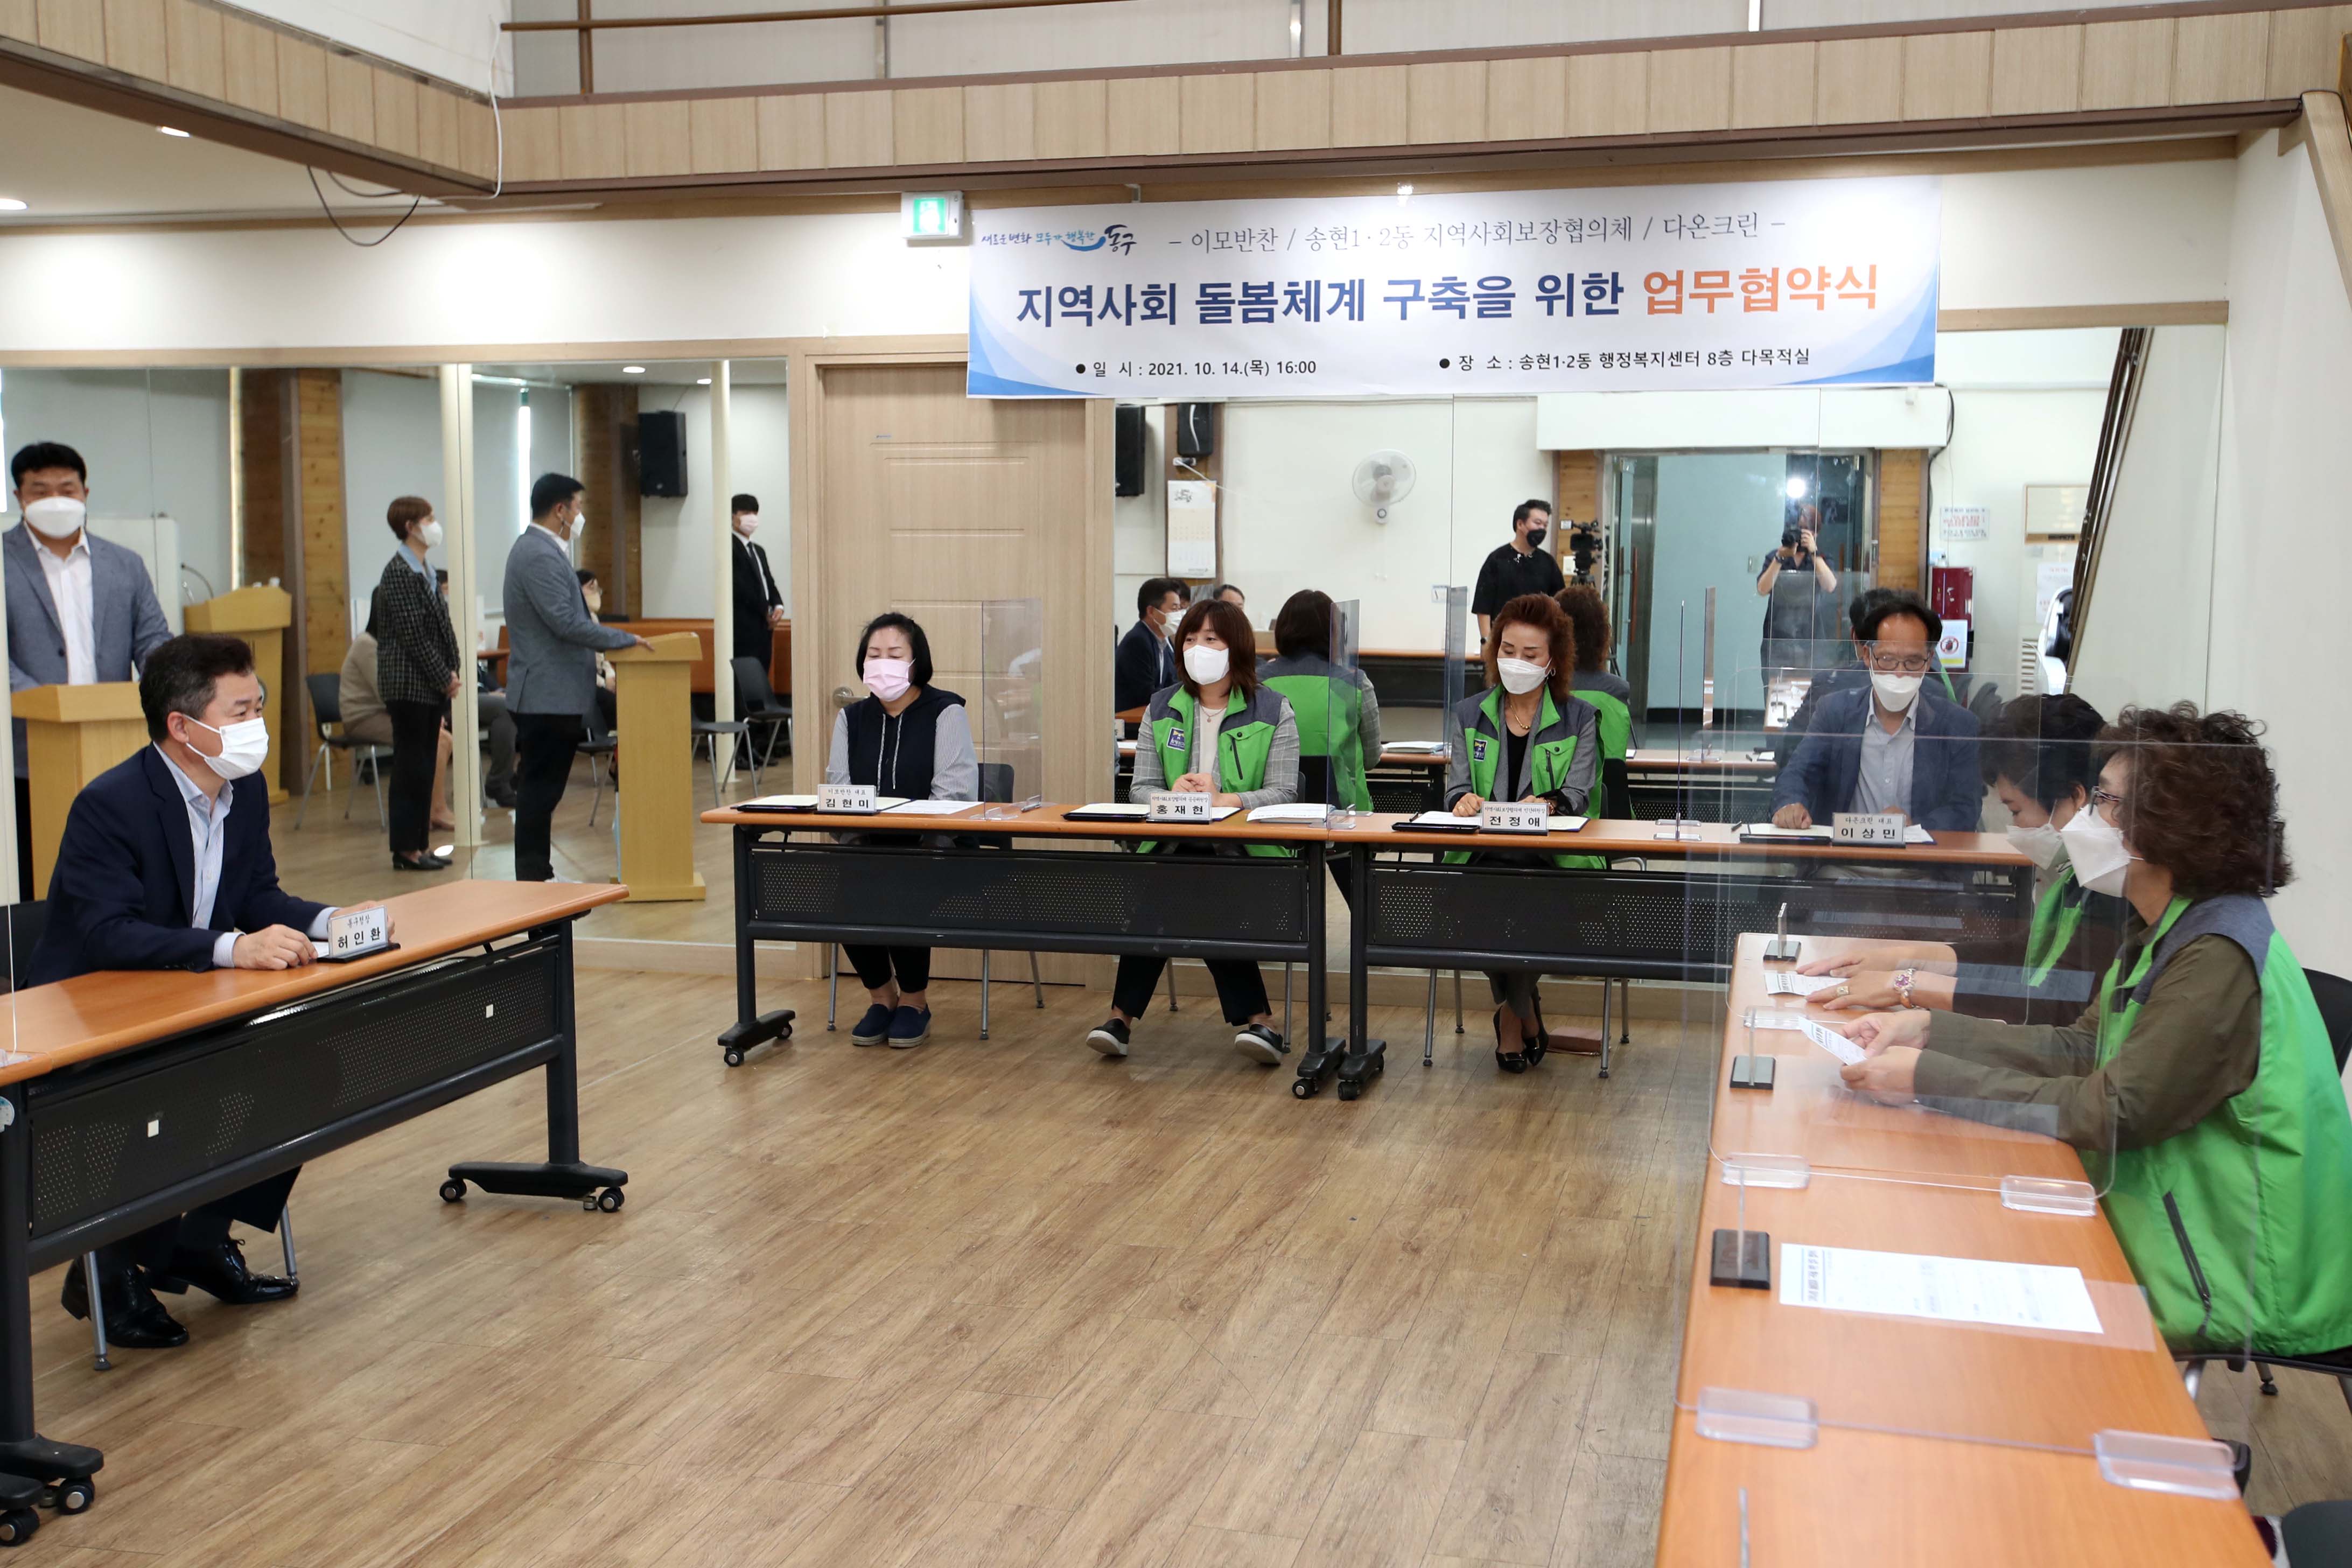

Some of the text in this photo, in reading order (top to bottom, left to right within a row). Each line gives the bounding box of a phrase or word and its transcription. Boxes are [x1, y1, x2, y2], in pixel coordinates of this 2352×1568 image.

[982, 229, 1096, 246] 새로운 변화 모두가 행복한
[1102, 224, 1137, 256] 동구
[1191, 227, 1278, 254] 이모반찬
[1286, 228, 1296, 251] /
[1305, 226, 1413, 252] 송현1·2동
[1425, 214, 1632, 249] 지역사회보장협의체
[1643, 216, 1653, 241] /
[1663, 212, 1757, 240] 다온크린
[1017, 265, 1876, 327] 지역사회 돌봄체계 구축을 위한 업무협약식
[1149, 362, 1187, 375] 2021.
[1194, 362, 1215, 375] 10.
[1222, 360, 1269, 377] 14.(목)
[1277, 361, 1316, 374] 16:00
[1599, 351, 1699, 369] 행정복지센터
[1707, 349, 1733, 366] 8층
[1742, 348, 1809, 366] 다목적실
